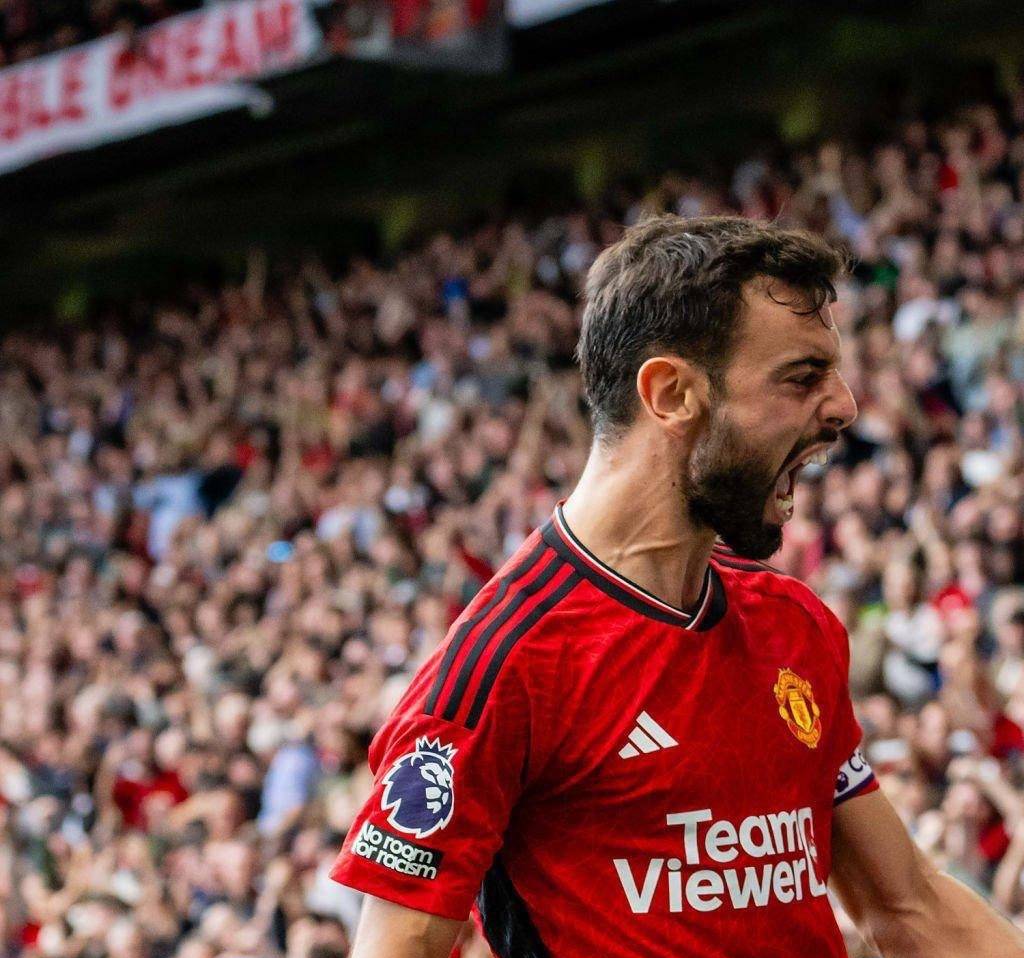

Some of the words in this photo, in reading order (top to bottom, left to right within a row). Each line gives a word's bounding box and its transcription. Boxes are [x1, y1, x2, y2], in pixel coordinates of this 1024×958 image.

[359, 820, 383, 846] No
[382, 836, 434, 865] room
[666, 808, 804, 866] Team
[375, 849, 438, 880] racism
[612, 857, 807, 914] Viewer
